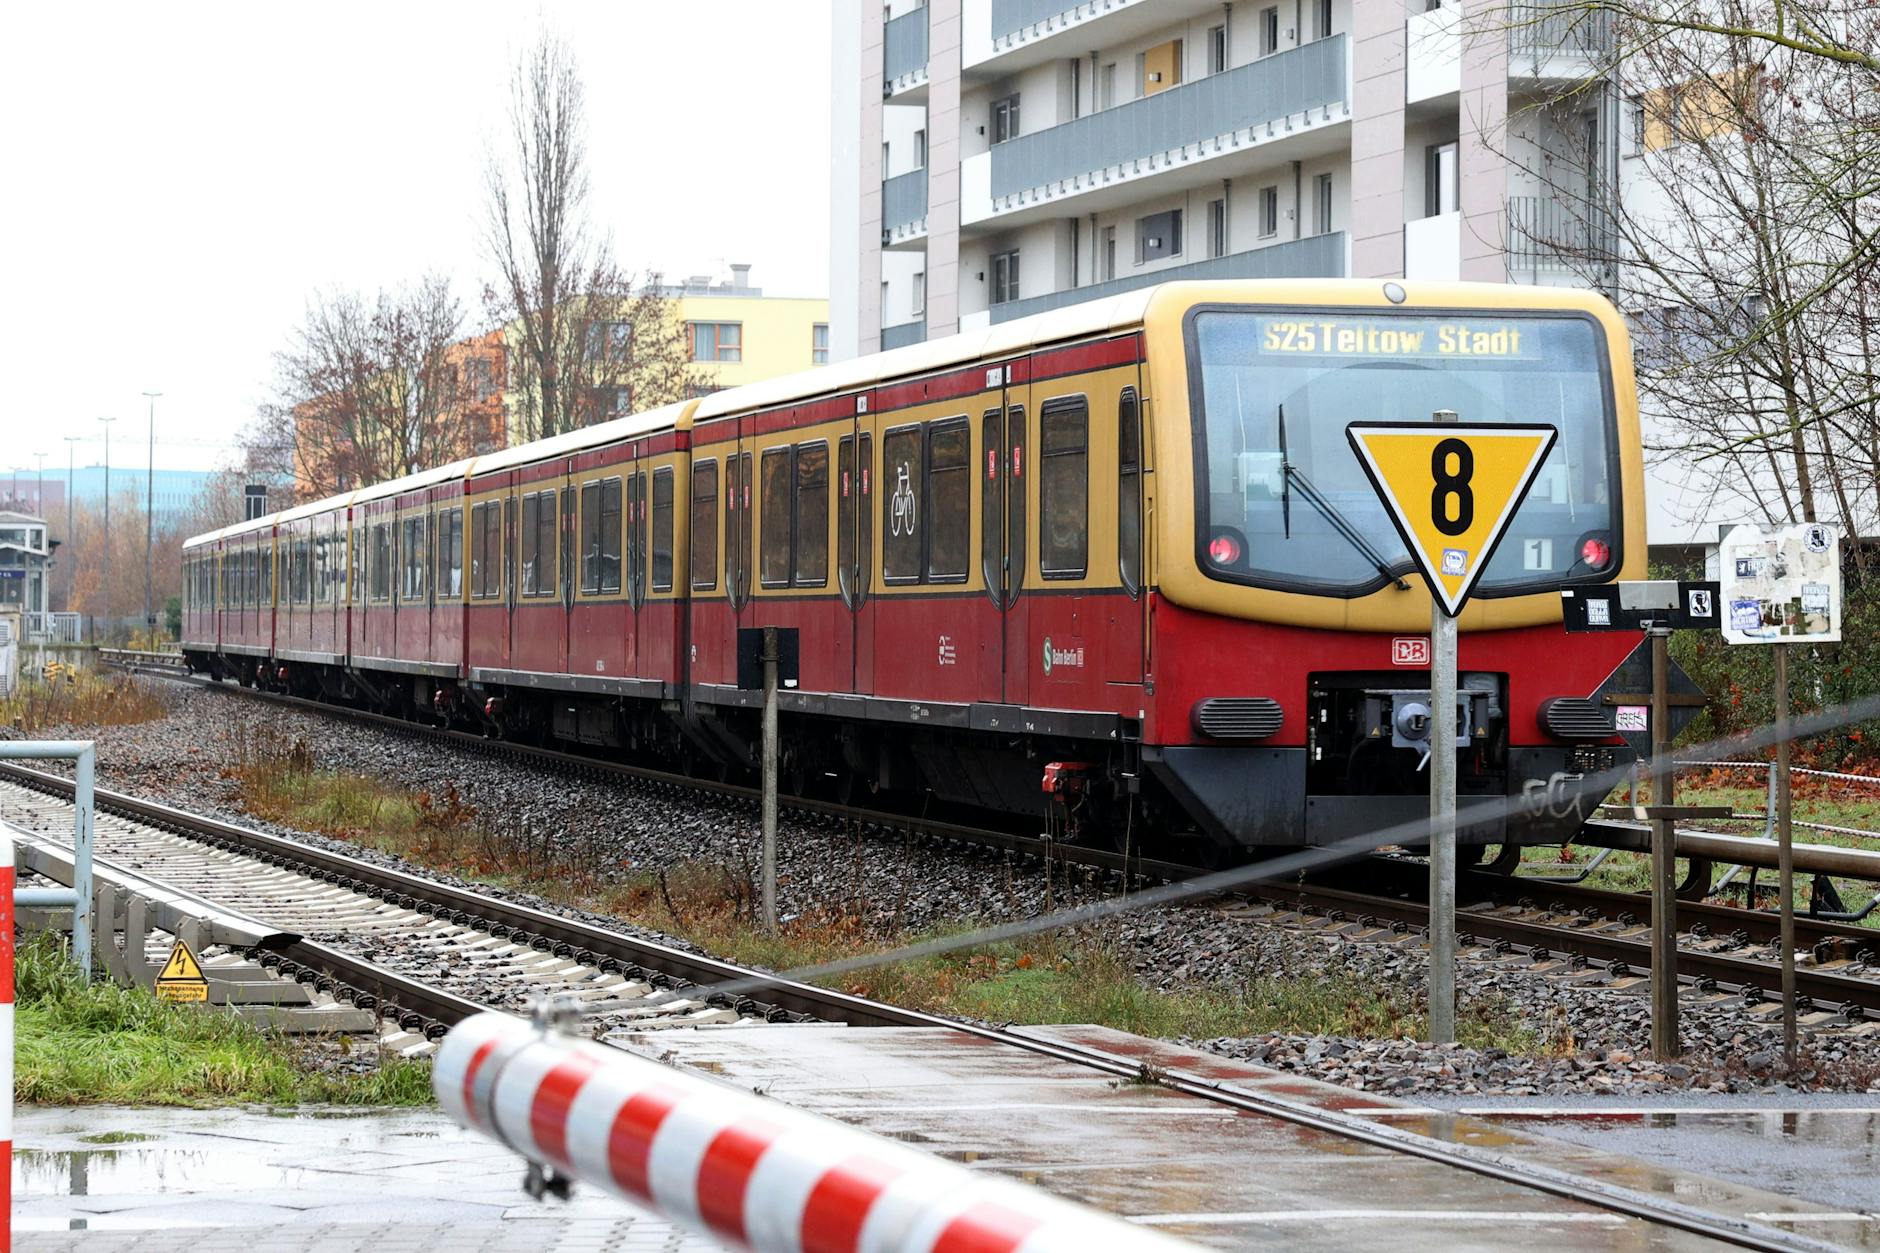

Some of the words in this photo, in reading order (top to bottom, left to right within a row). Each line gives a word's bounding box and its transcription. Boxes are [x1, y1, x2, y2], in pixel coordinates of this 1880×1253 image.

[1263, 321, 1315, 352] S25
[1319, 322, 1424, 353] Teltow
[1438, 324, 1522, 355] Stadt
[1431, 437, 1474, 537] 8
[1531, 540, 1543, 569] 1
[1052, 648, 1063, 665] Bahn
[1063, 648, 1077, 666] Berlin
[1396, 640, 1426, 661] DB
